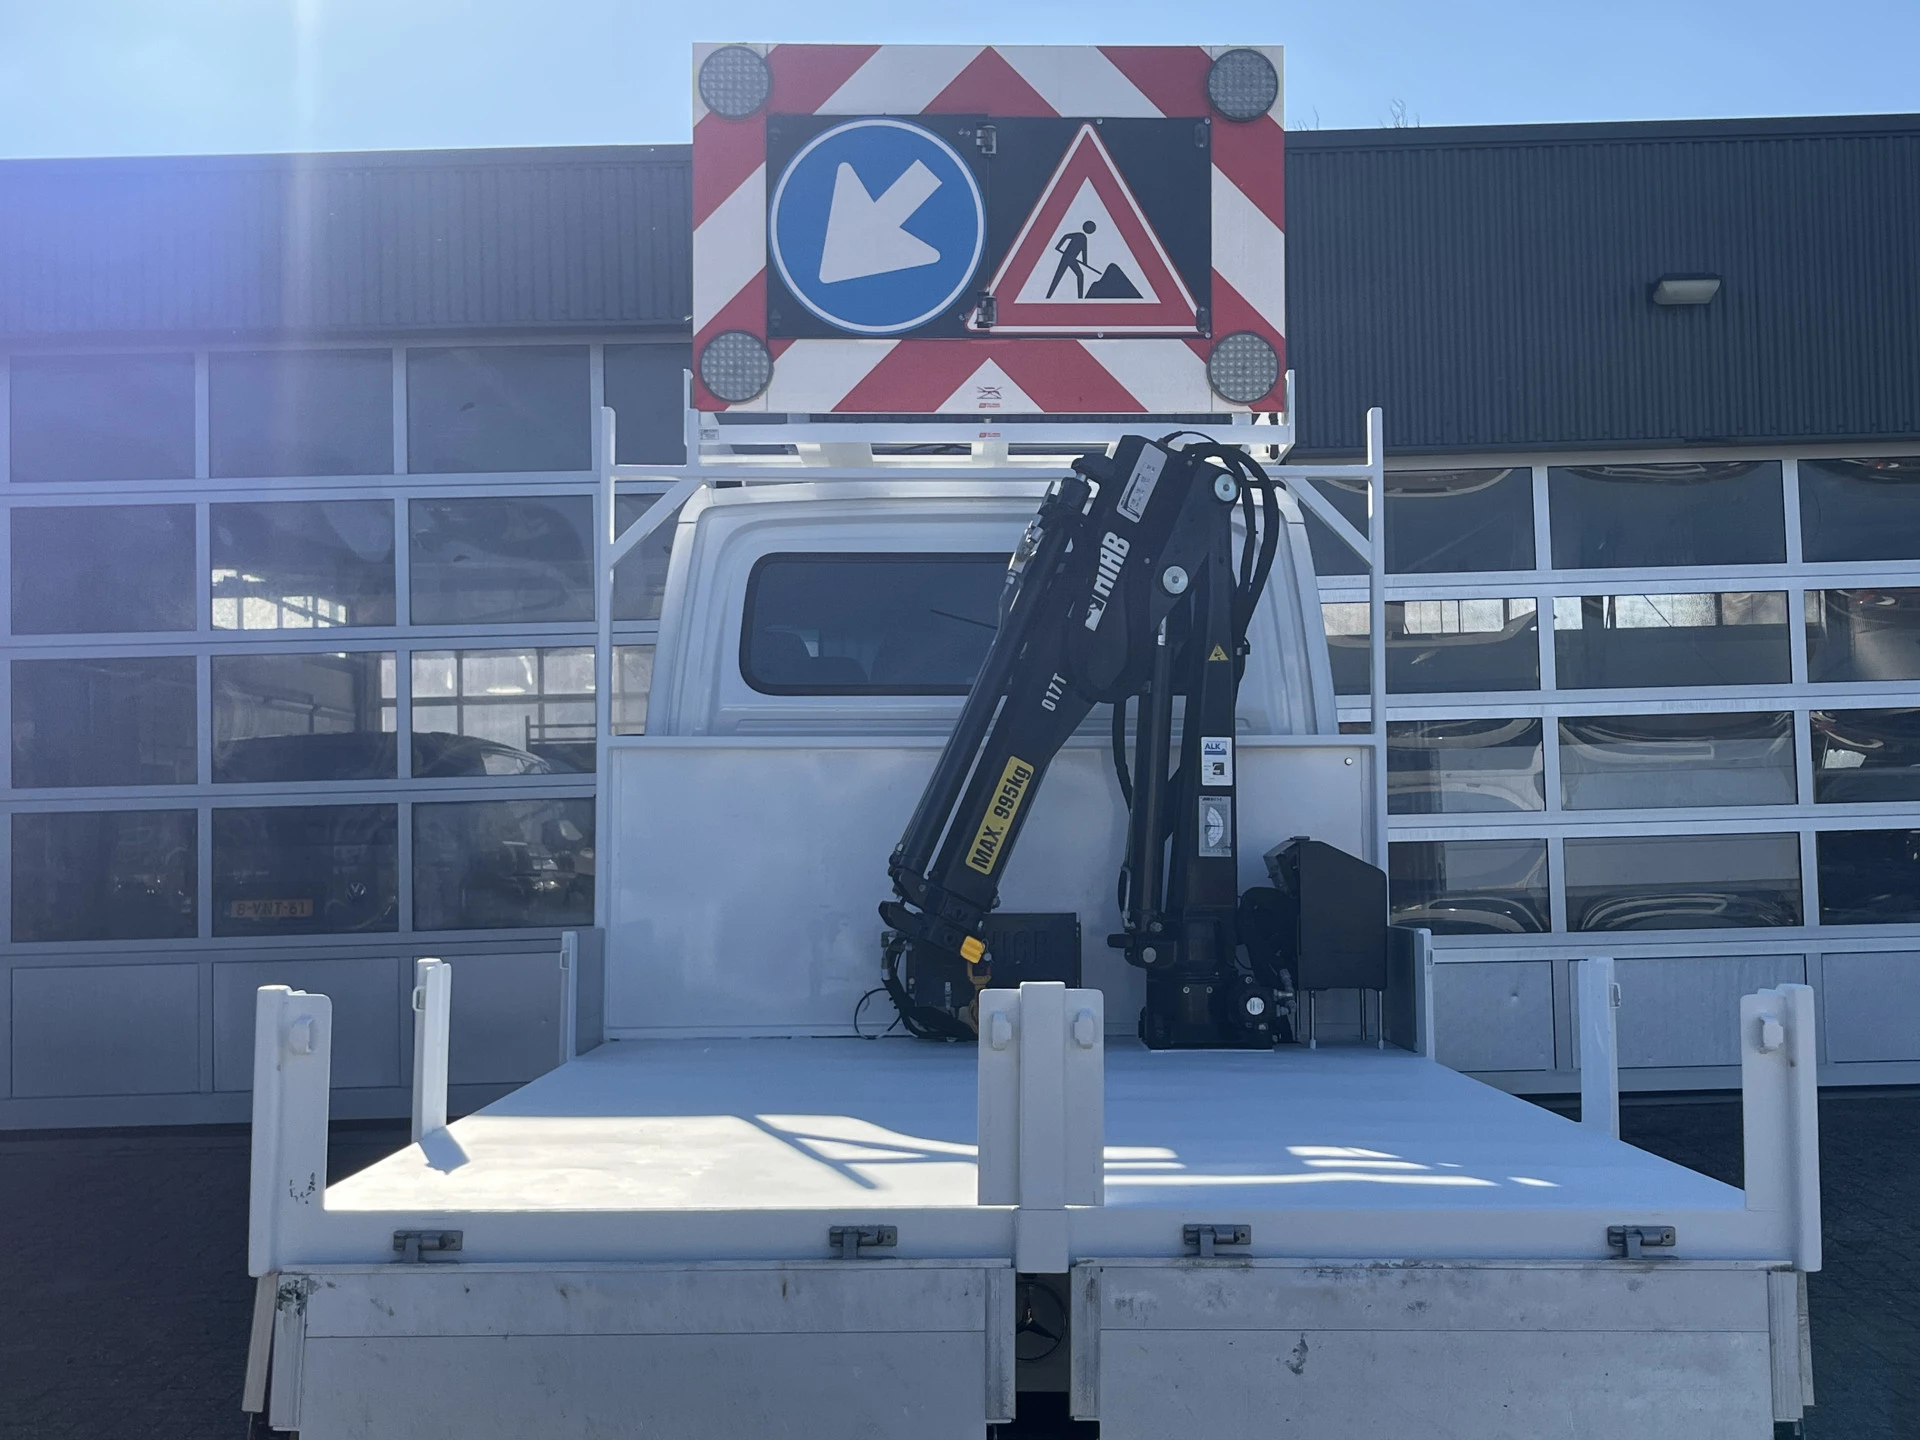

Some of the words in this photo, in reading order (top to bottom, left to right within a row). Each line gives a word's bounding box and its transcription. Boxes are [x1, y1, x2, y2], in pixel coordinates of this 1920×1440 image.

[1093, 531, 1131, 598] HIAB
[1041, 672, 1067, 712] 017T
[971, 825, 1004, 869] MAX.
[993, 765, 1032, 819] 995kg
